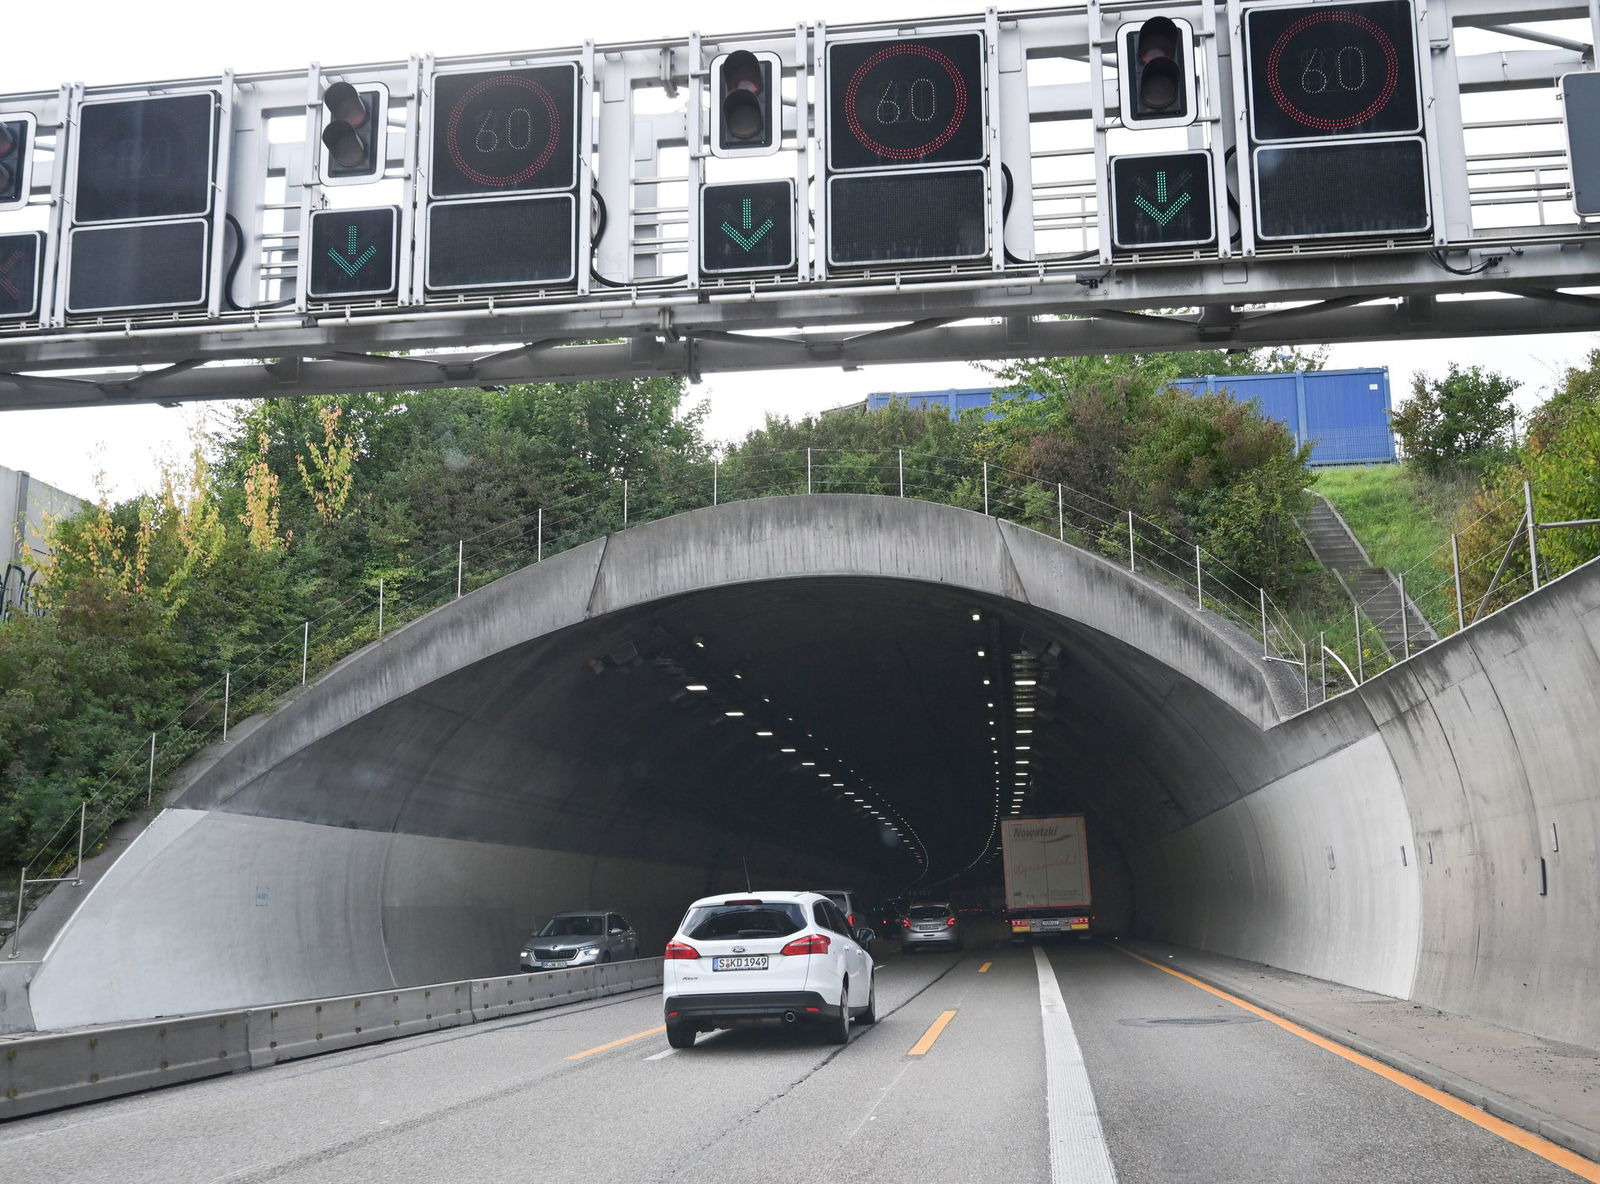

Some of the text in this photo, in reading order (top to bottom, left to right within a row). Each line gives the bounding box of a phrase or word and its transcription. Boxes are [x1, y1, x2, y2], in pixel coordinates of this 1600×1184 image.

[1301, 46, 1365, 94] 60
[876, 78, 935, 124] 60
[475, 108, 531, 153] 60
[1013, 826, 1058, 839] Nowatzki
[744, 957, 767, 967] 1949
